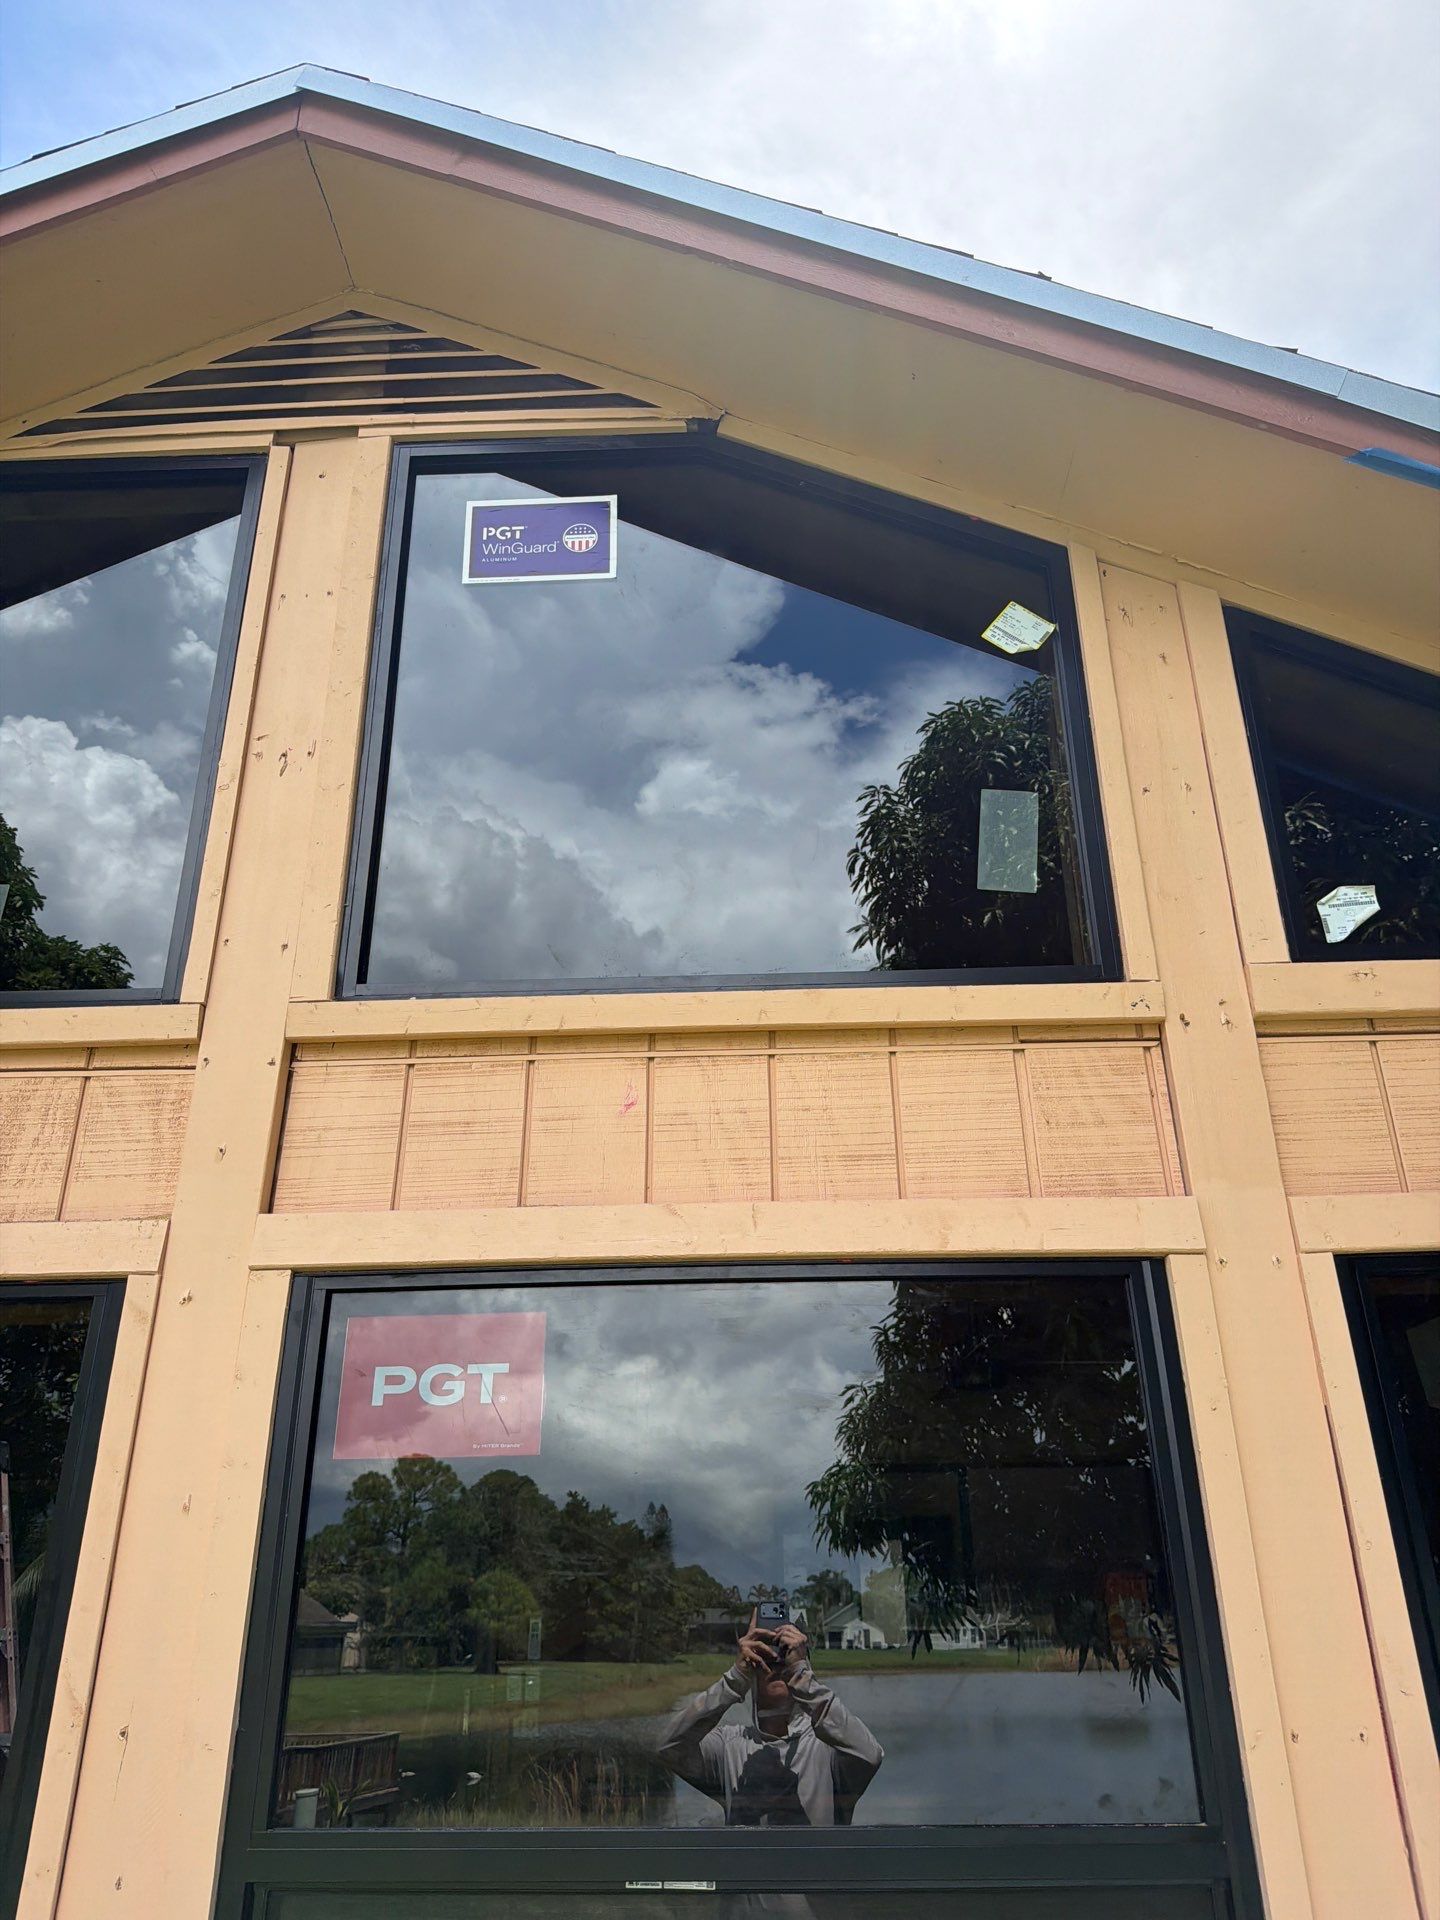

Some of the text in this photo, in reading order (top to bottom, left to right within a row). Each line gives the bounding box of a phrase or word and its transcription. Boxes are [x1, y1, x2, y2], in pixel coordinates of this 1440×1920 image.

[482, 526, 525, 540] PGT
[482, 541, 557, 555] WinGuard
[371, 1362, 510, 1407] PGT
